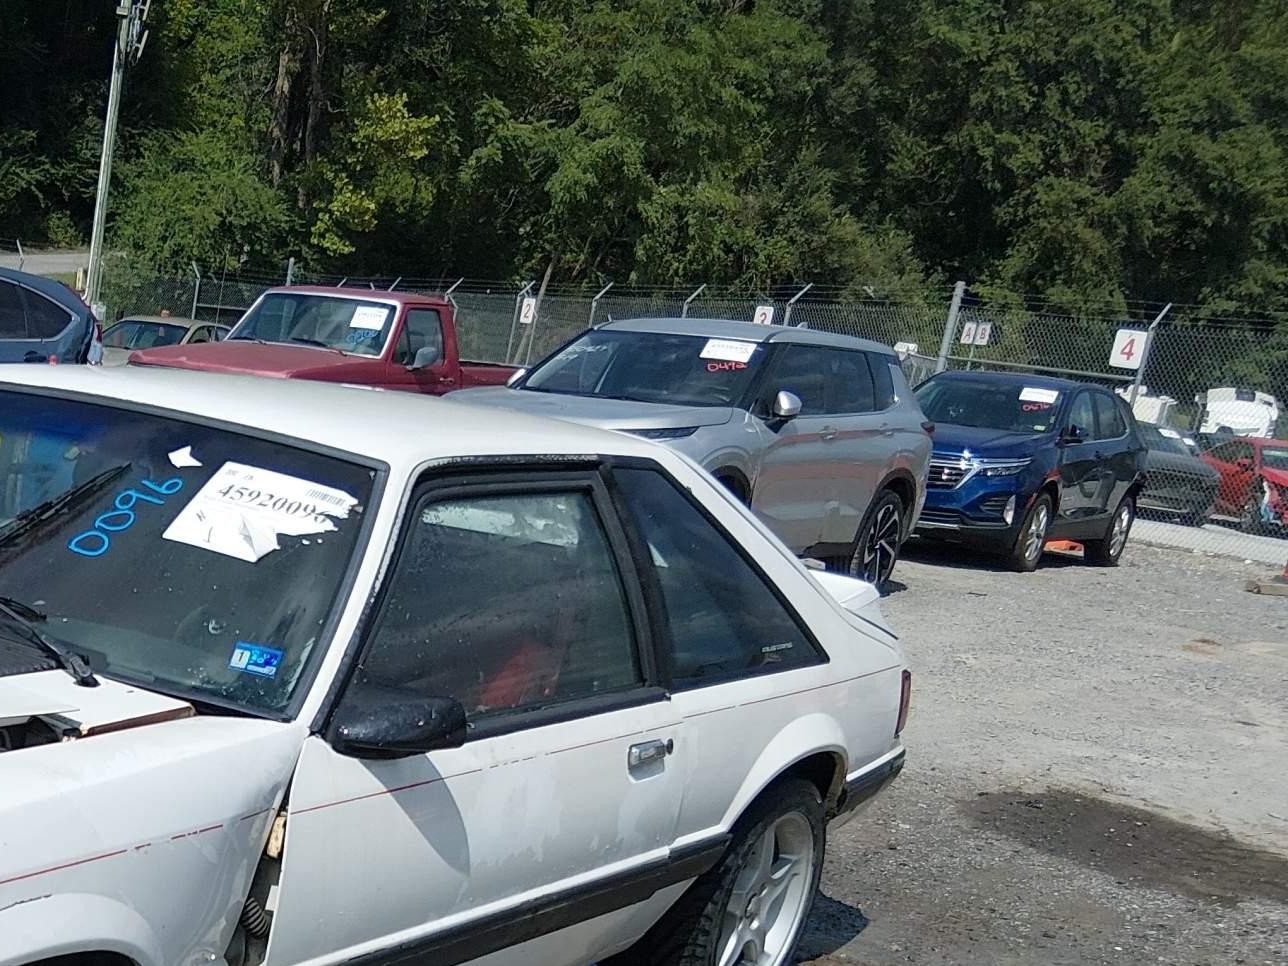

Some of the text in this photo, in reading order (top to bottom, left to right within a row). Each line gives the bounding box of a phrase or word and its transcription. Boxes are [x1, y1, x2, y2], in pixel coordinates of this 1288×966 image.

[523, 303, 531, 319] 2
[965, 327, 972, 339] A
[979, 327, 987, 340] B
[1120, 338, 1136, 361] 4
[68, 477, 184, 557] 0096
